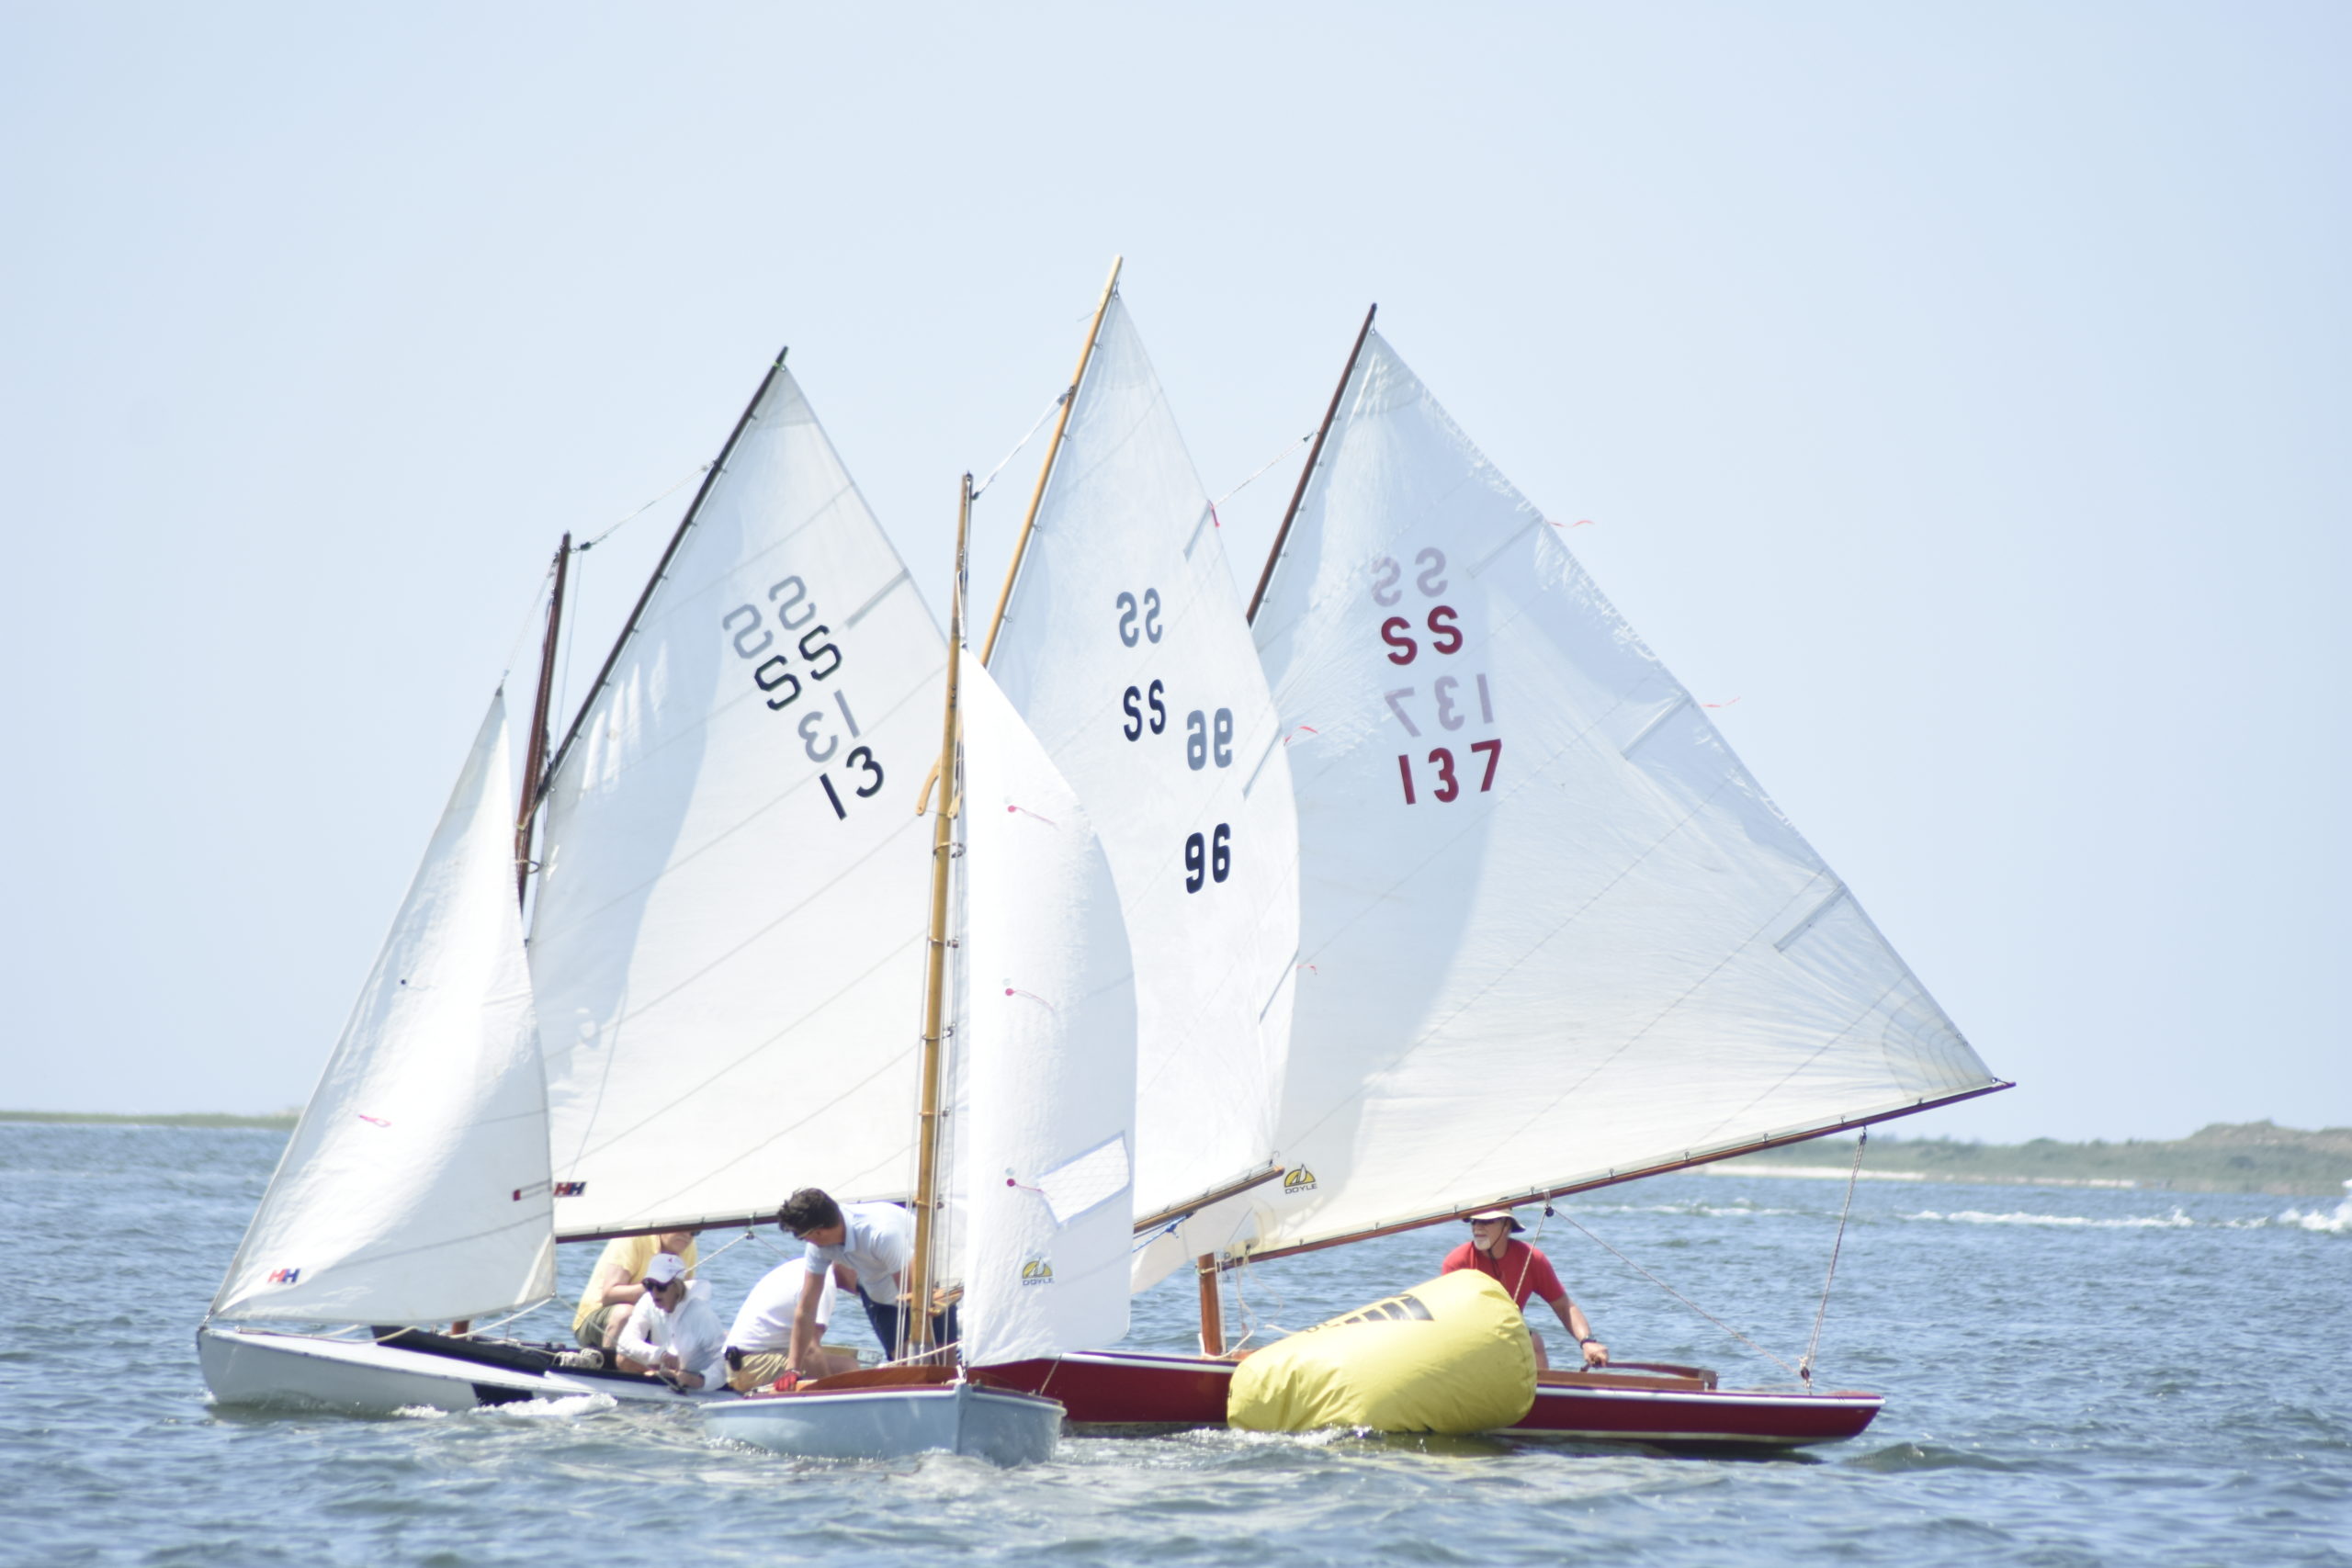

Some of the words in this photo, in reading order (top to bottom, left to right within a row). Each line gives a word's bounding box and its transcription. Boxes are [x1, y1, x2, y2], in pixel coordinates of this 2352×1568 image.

[753, 625, 842, 711] SS
[1381, 605, 1464, 666] SS
[1123, 679, 1167, 742] SS
[819, 745, 885, 821] 13
[1397, 738, 1502, 806] 137
[1184, 822, 1231, 895] 96
[1284, 1182, 1317, 1194] DOYLE
